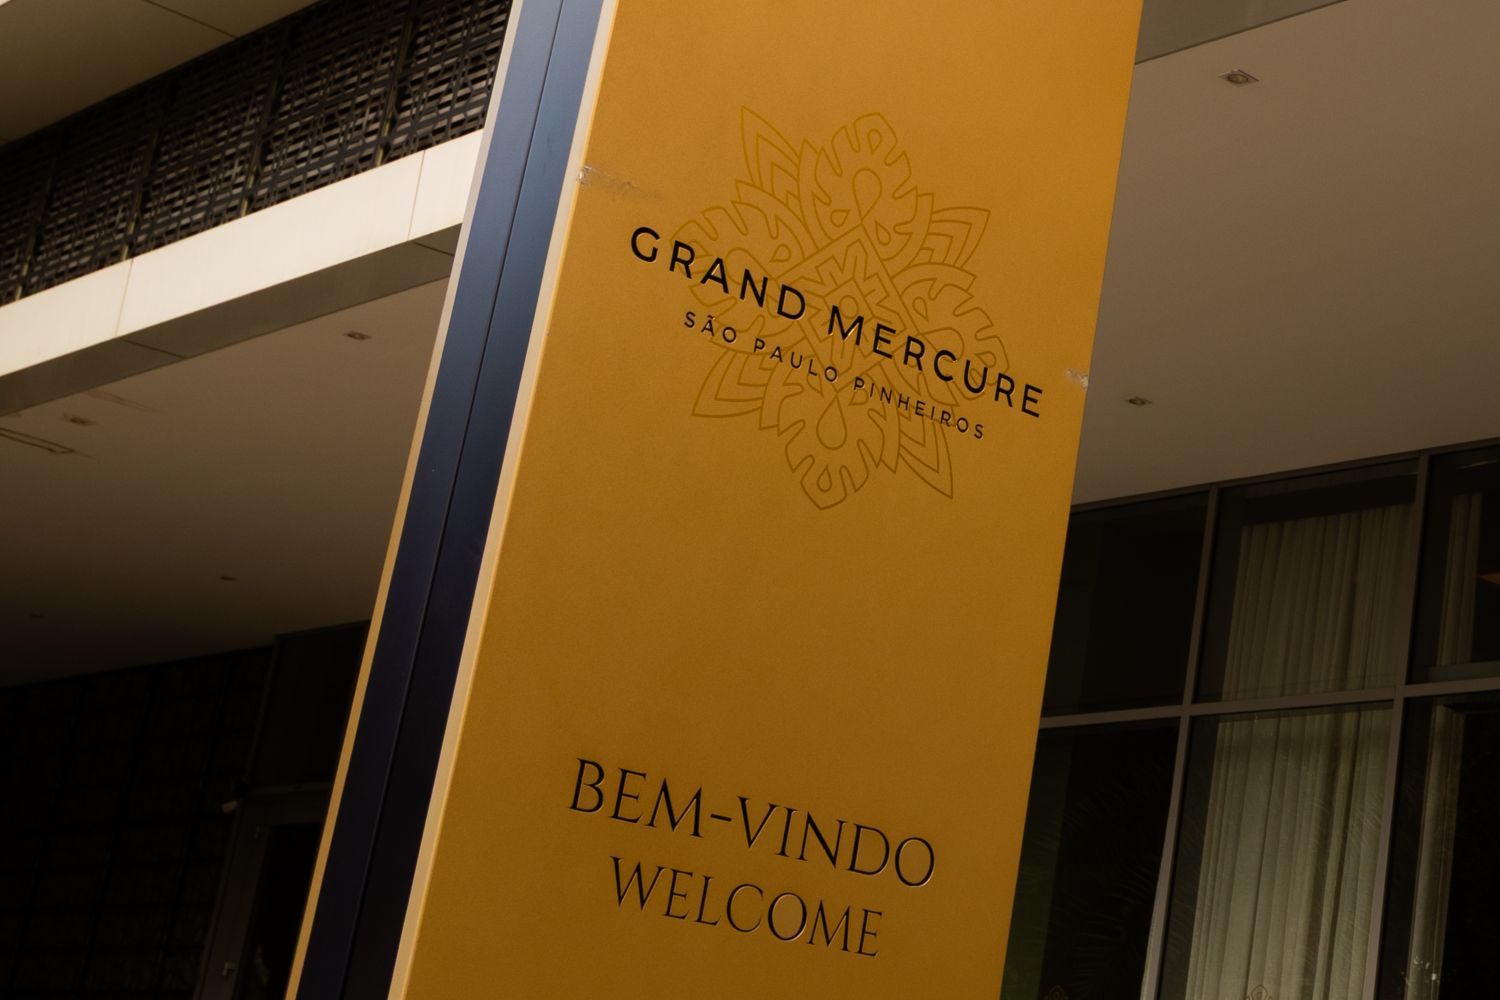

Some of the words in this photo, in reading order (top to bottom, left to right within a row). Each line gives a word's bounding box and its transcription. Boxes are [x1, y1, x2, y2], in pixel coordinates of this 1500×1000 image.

[629, 226, 806, 320] GRAND
[828, 305, 1044, 418] MERCURE
[683, 310, 738, 344] SÃO
[752, 337, 838, 383] PAULO
[853, 375, 986, 440] PINHEIROS
[567, 757, 935, 888] BEM-VINDO
[609, 855, 883, 958] WELCOME
